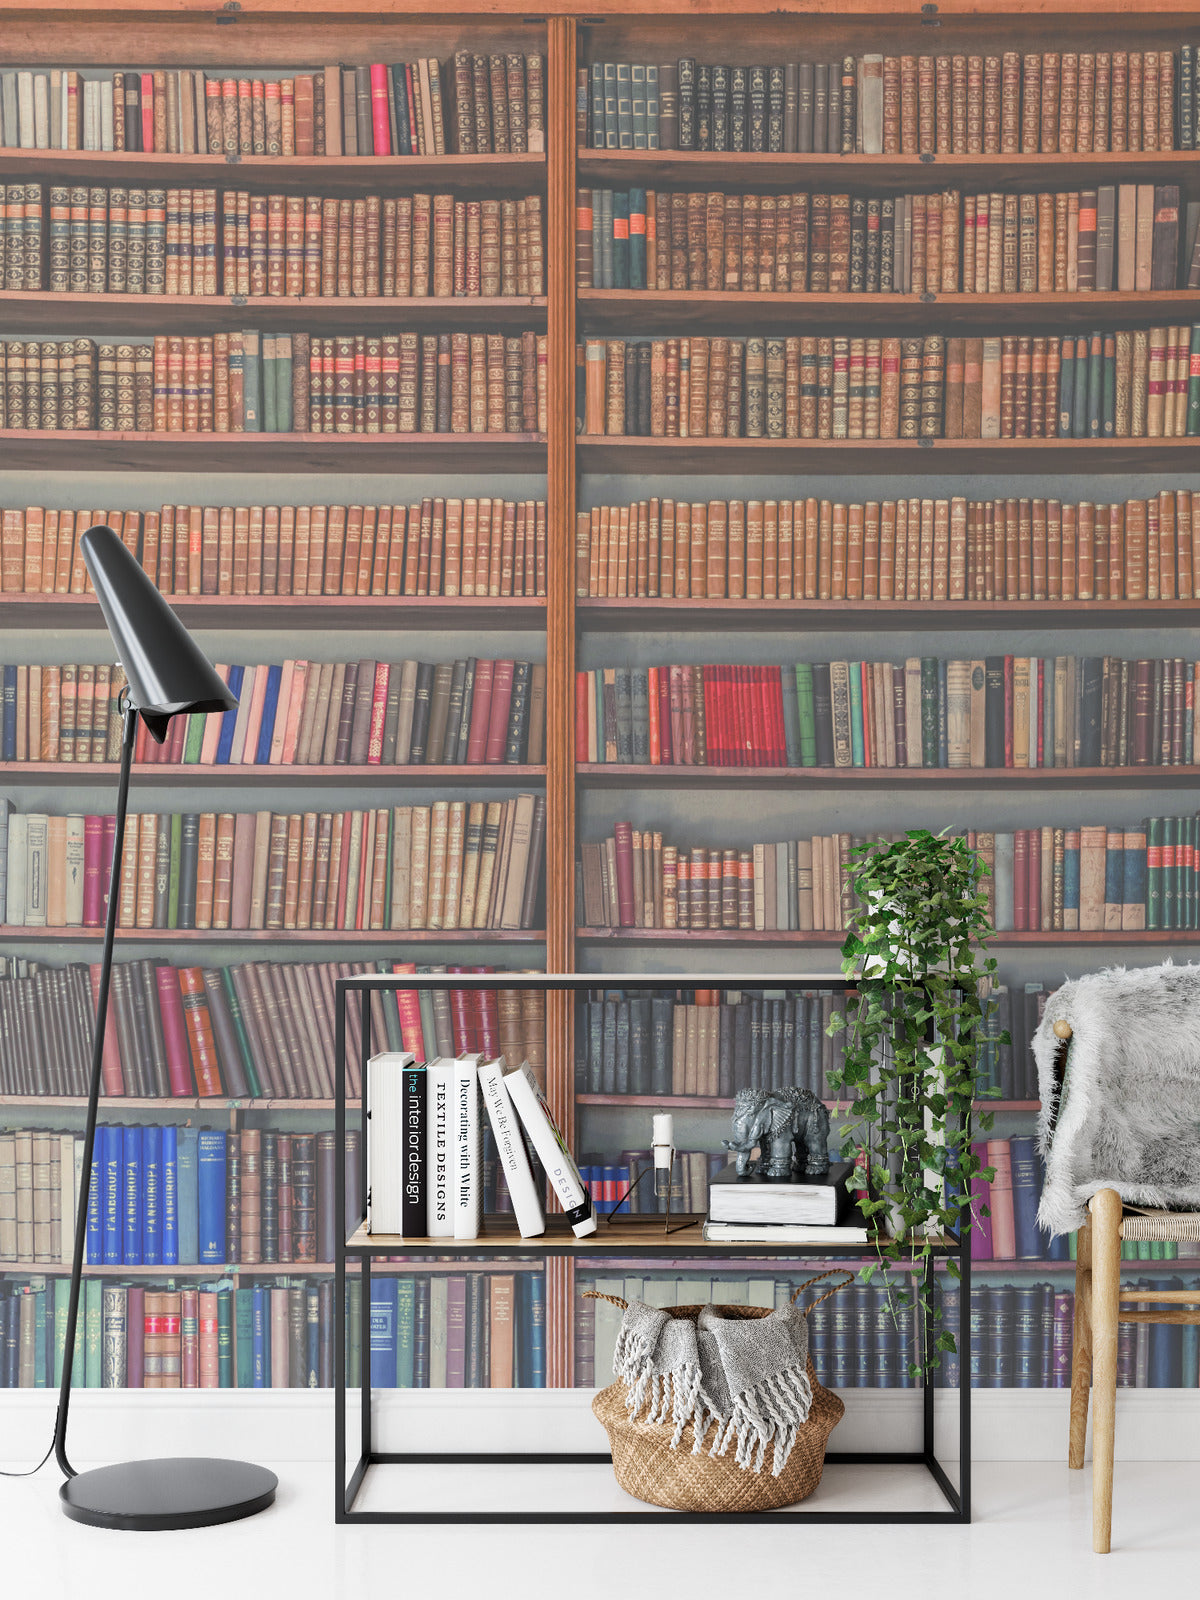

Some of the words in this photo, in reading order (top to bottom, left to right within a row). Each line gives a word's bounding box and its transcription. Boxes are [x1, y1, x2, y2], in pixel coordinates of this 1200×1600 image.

[408, 1074, 418, 1093] the
[486, 1077, 499, 1097] May
[437, 1083, 446, 1148] TEXTILE
[458, 1079, 471, 1142] Decorating
[494, 1099, 504, 1116] We
[497, 1116, 508, 1130] Be
[460, 1145, 471, 1169] with
[501, 1130, 519, 1171] Forgiven
[437, 1153, 446, 1221] DESIGNS
[460, 1173, 471, 1208] White
[553, 1168, 583, 1219] DESIGN
